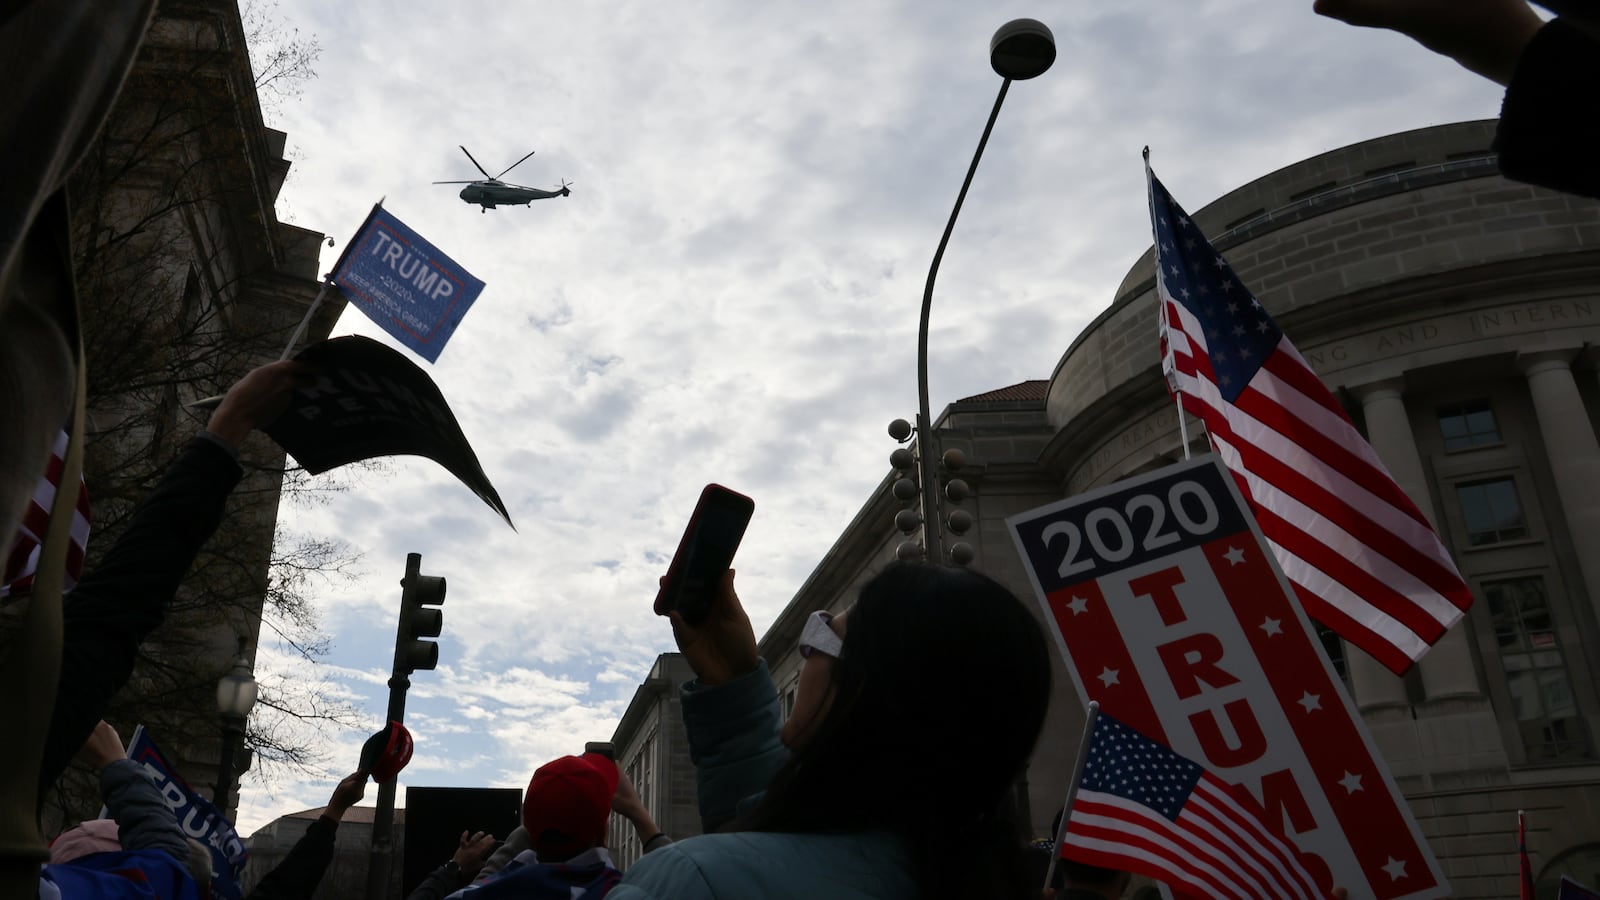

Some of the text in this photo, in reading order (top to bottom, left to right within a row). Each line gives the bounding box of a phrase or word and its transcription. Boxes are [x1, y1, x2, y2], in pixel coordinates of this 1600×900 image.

[371, 230, 454, 301] TRUMP
[1376, 325, 1439, 352] AND
[297, 368, 451, 425] RUMP
[1040, 479, 1220, 579] 2020
